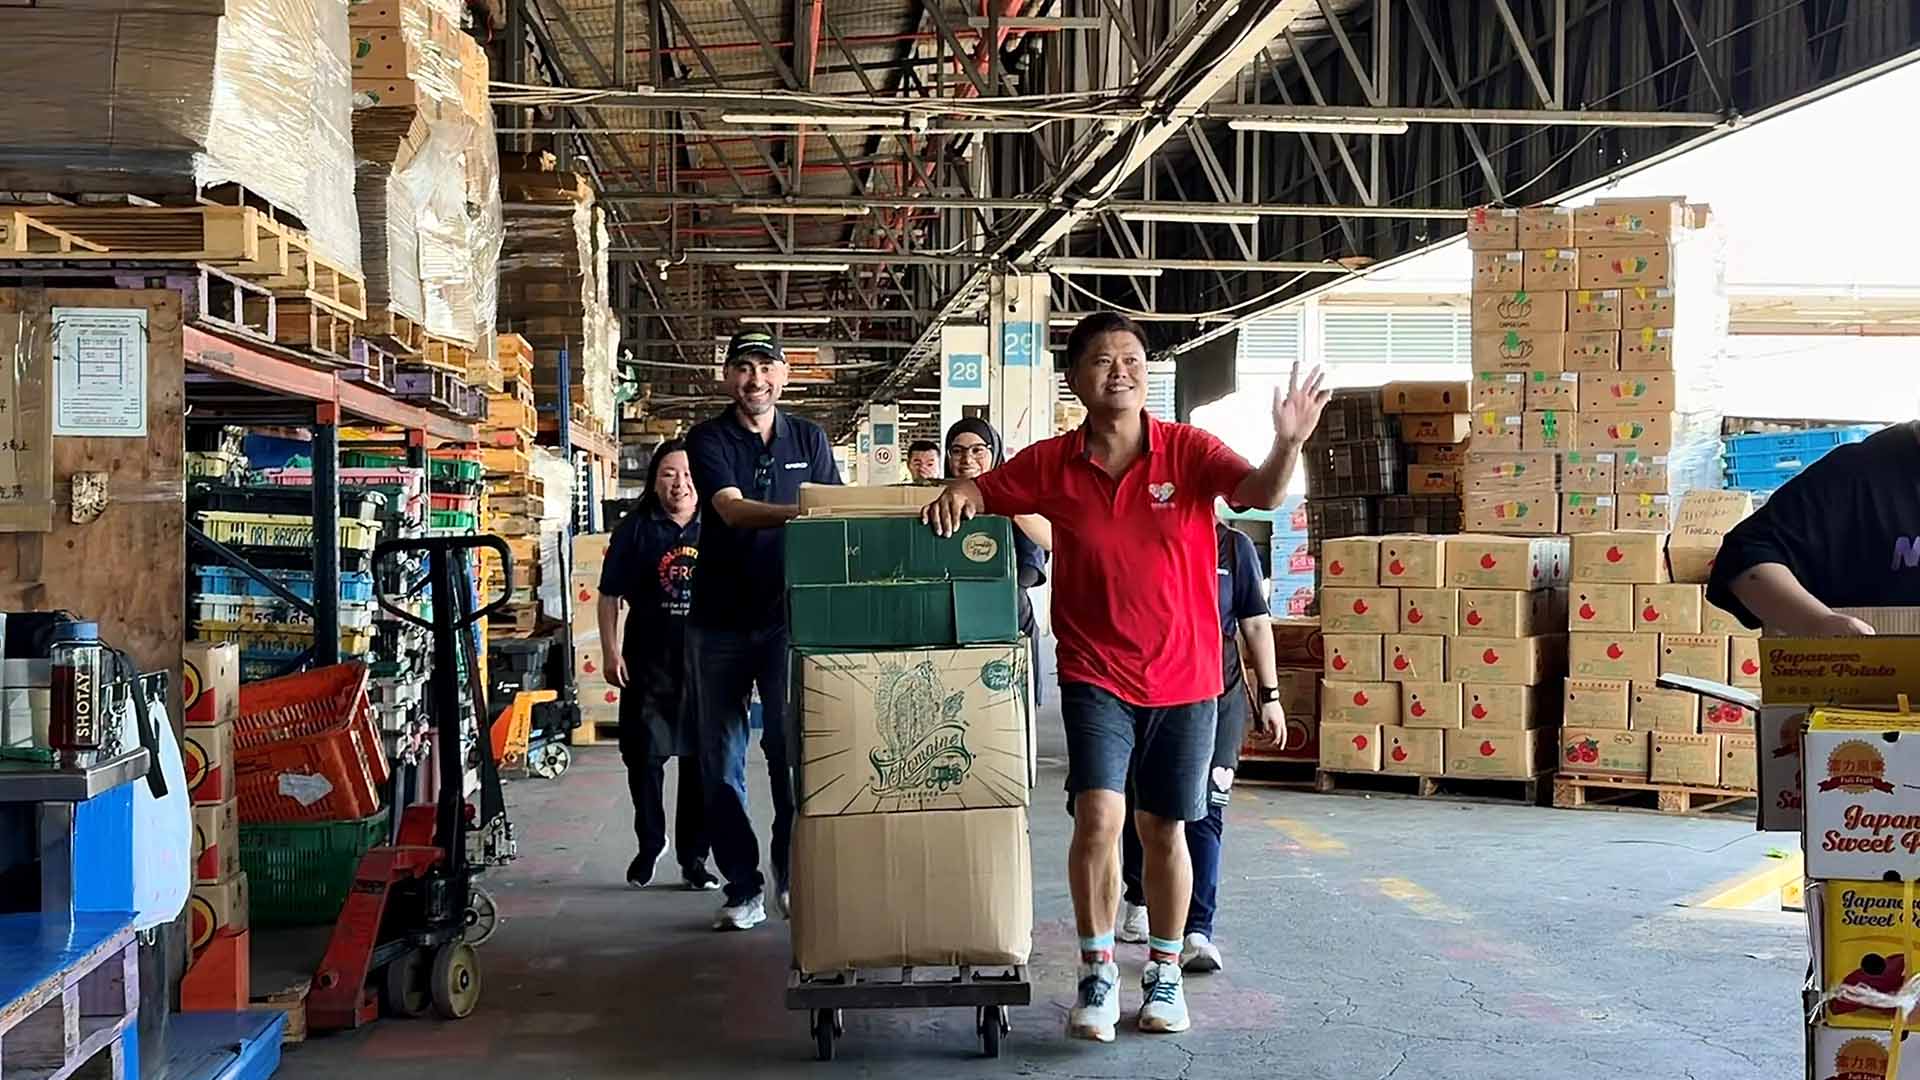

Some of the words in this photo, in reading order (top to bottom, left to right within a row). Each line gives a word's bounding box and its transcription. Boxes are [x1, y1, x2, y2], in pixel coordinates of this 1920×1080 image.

[952, 361, 979, 382] 28
[878, 452, 889, 462] 10
[1769, 648, 1861, 664] Japanese
[1771, 664, 1827, 678] Sweet
[1831, 663, 1897, 678] Potato
[75, 671, 90, 737] SHOTAY
[1822, 830, 1896, 853] Sweet
[1842, 911, 1895, 927] Sweet
